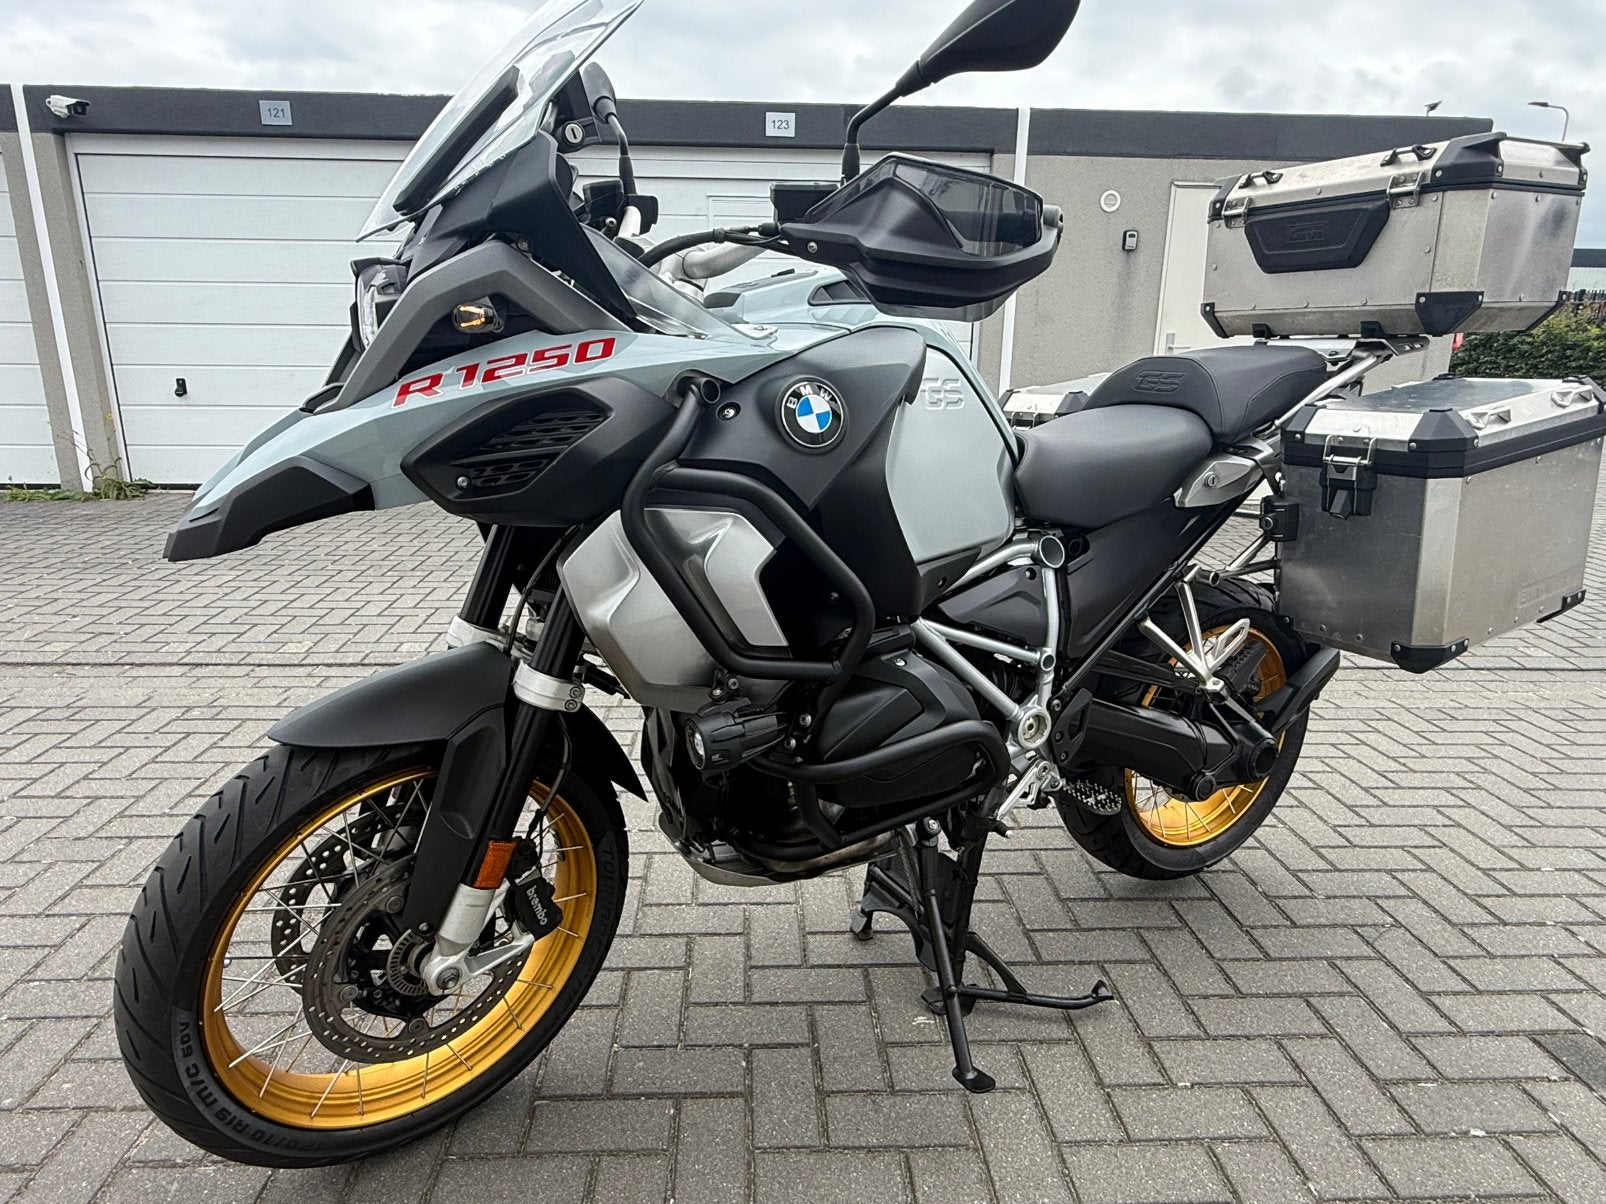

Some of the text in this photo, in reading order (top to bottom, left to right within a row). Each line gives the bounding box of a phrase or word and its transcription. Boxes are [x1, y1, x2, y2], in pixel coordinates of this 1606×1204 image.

[267, 107, 286, 118] 121
[771, 119, 790, 130] 123
[391, 336, 617, 409] R 1250
[1132, 369, 1186, 395] GS
[785, 384, 833, 410] BMW
[920, 377, 966, 411] GS
[525, 884, 549, 926] brembo
[178, 1020, 194, 1059] 60V
[184, 1061, 219, 1109] M/C
[214, 1105, 250, 1135] R19
